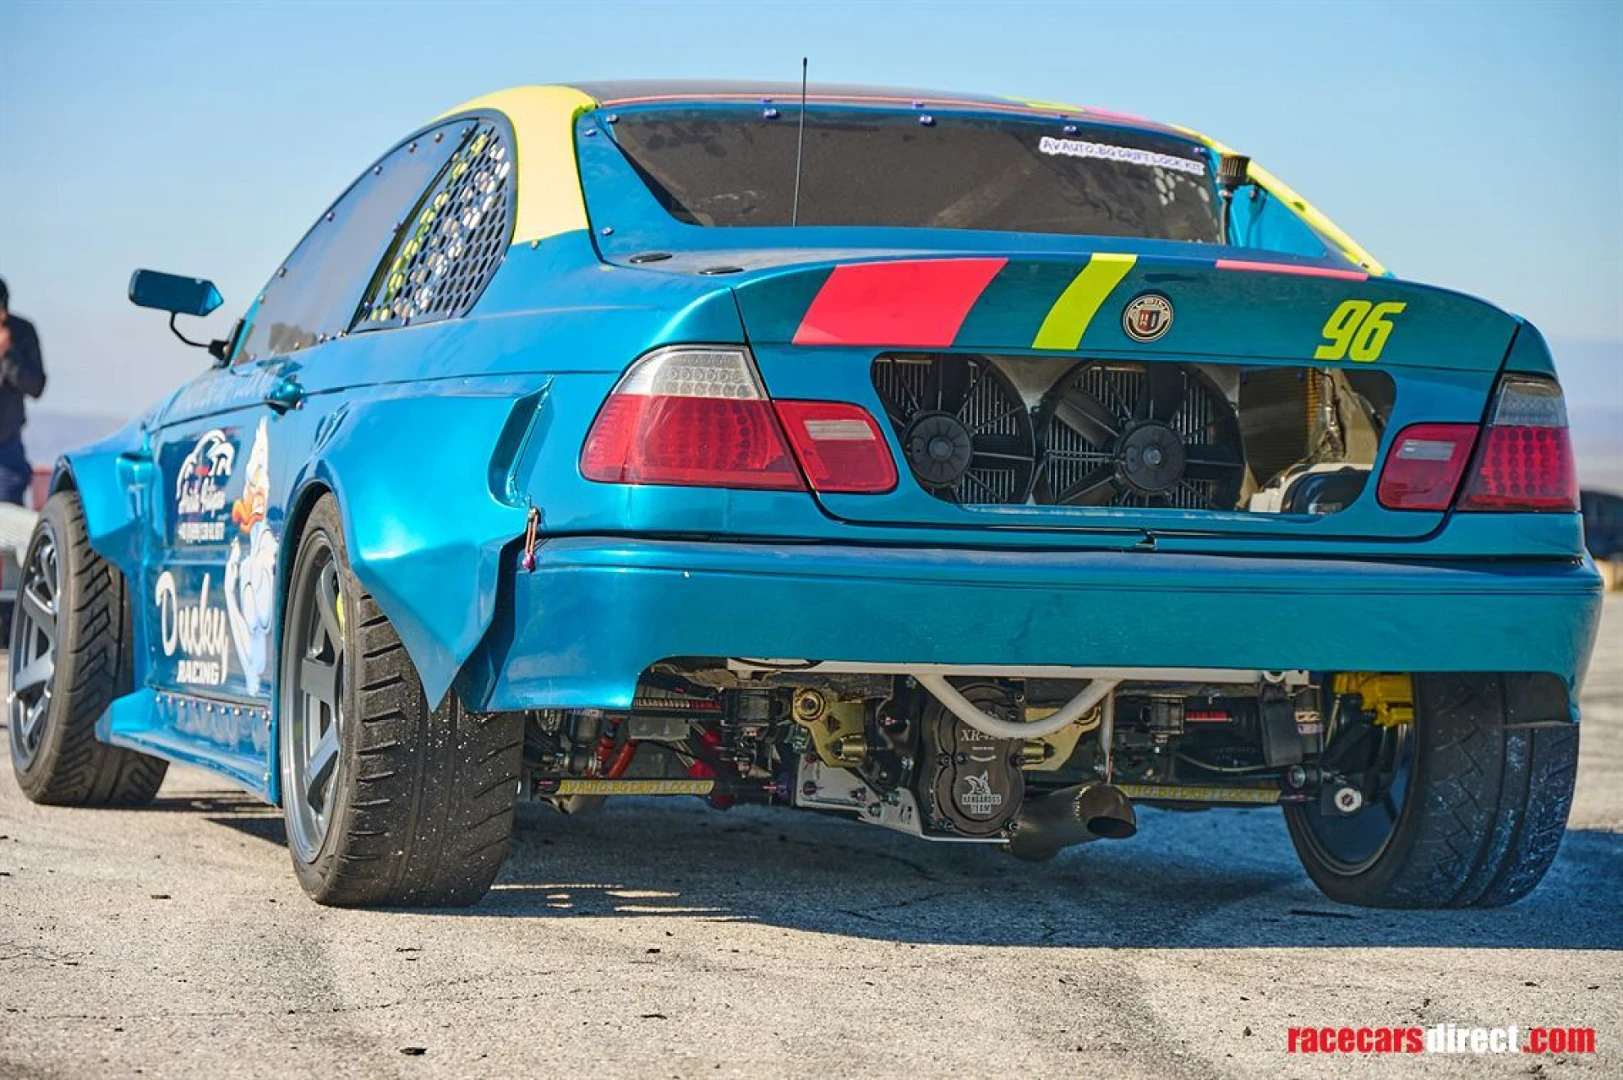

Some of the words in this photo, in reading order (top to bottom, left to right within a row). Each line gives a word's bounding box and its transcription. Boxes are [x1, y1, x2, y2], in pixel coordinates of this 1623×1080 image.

[1119, 149, 1150, 163] DRIFT
[1153, 153, 1180, 166] LOCK
[1185, 160, 1202, 171] KIT
[1314, 299, 1407, 362] 96
[155, 571, 229, 684] Ducky
[177, 659, 220, 685] RACING
[630, 781, 661, 793] DRIFT
[663, 781, 692, 793] LOCK
